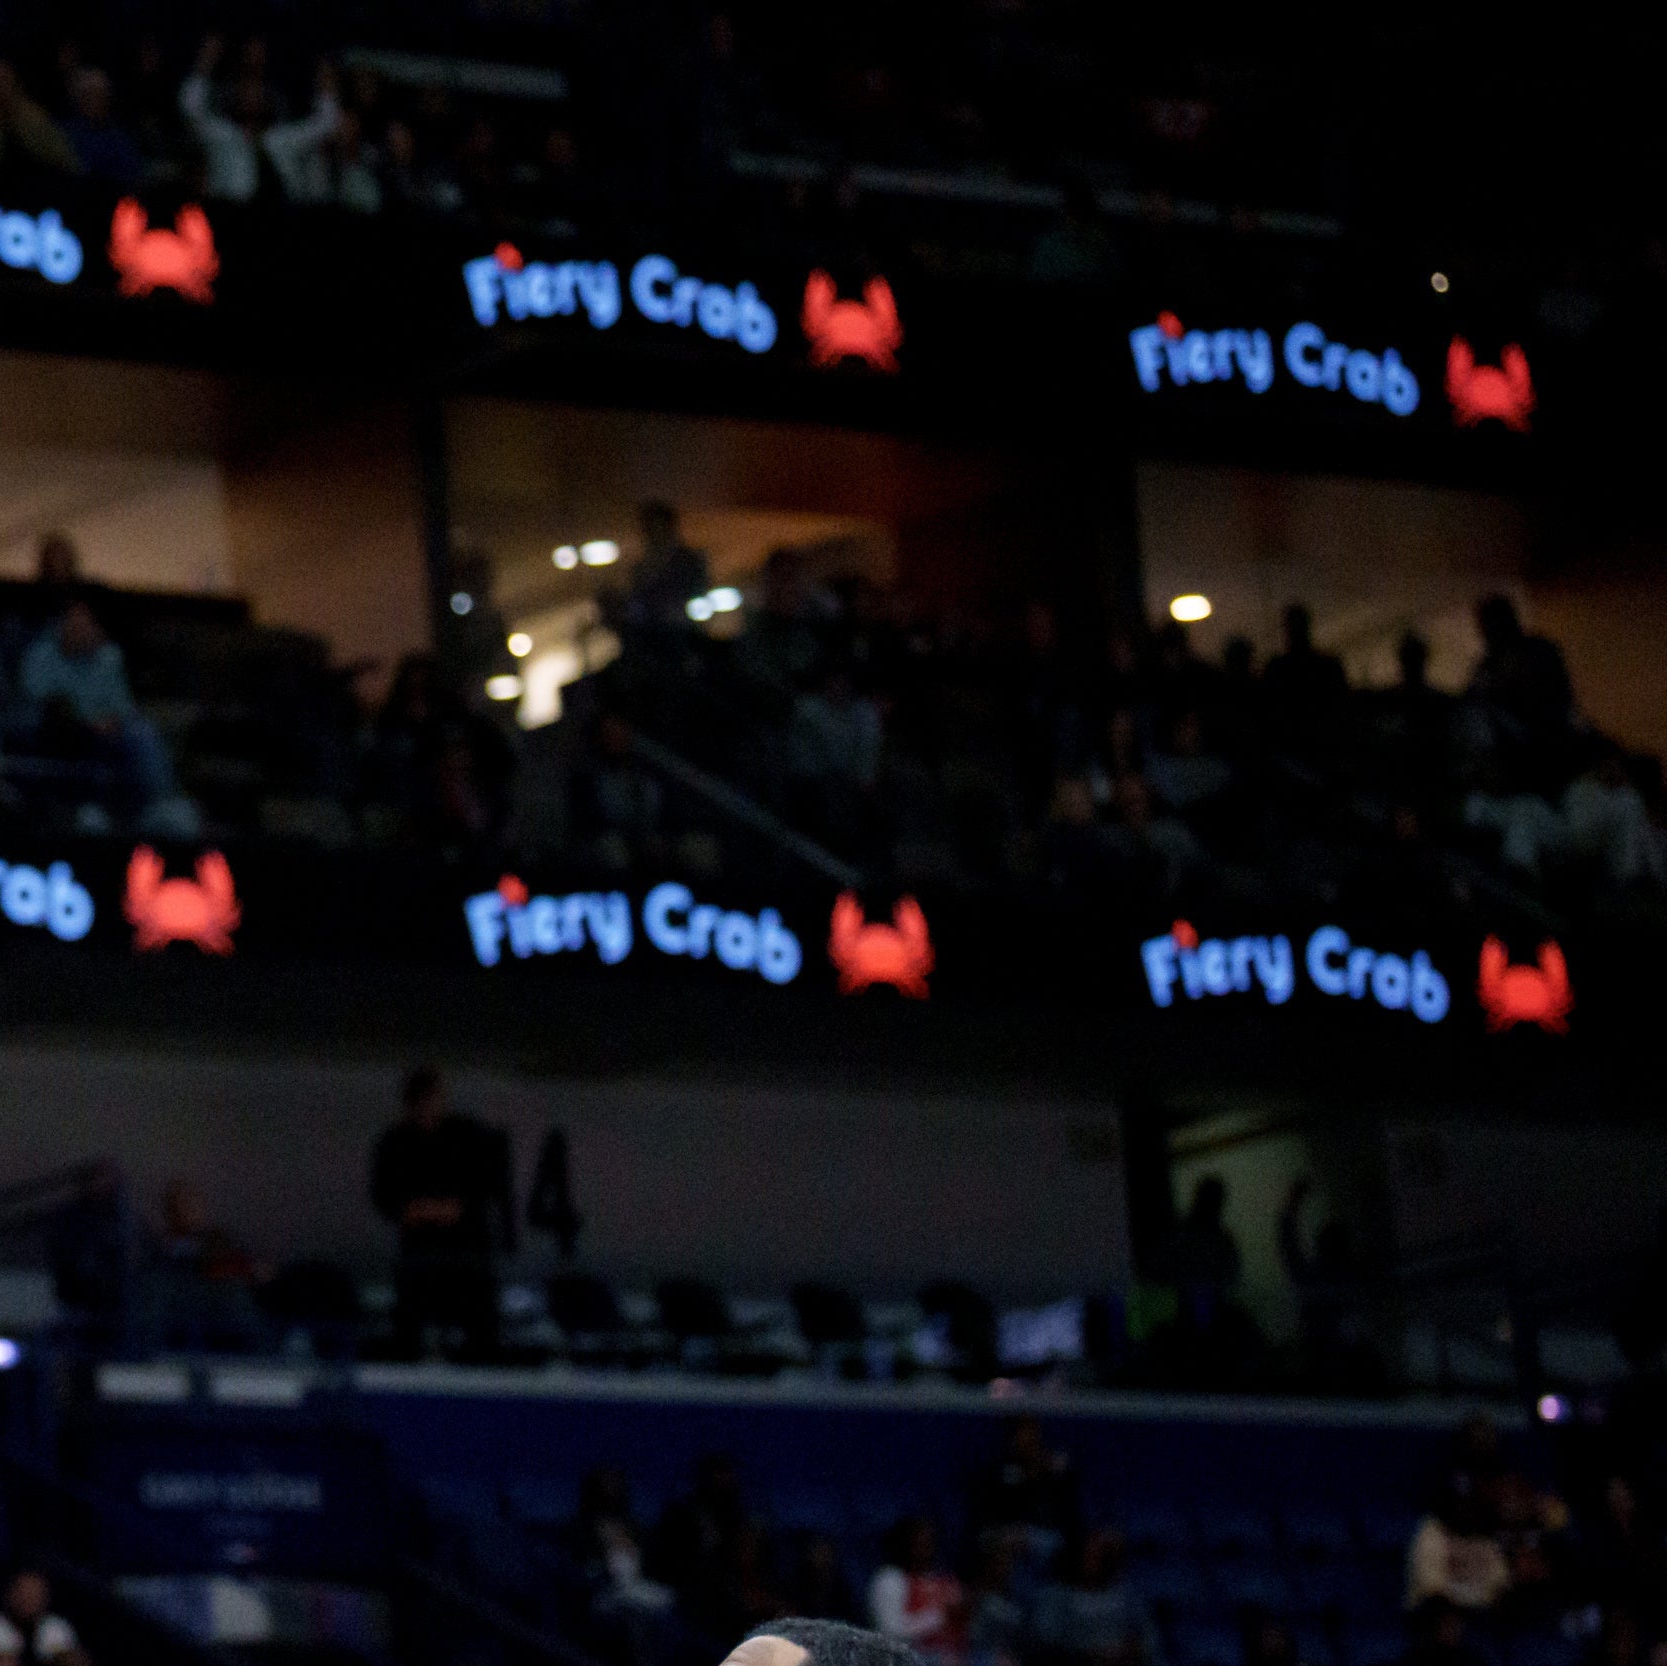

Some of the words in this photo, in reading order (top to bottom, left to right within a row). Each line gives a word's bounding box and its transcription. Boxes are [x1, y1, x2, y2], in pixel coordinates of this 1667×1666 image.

[464, 246, 621, 329] Fiery
[630, 255, 777, 353] Crab
[1130, 316, 1274, 393] Fiery
[1284, 323, 1419, 415] Crab
[465, 879, 633, 966] Fiery
[642, 882, 802, 984] Crab
[1142, 923, 1294, 1007] Fiery
[1306, 926, 1450, 1023] Crab
